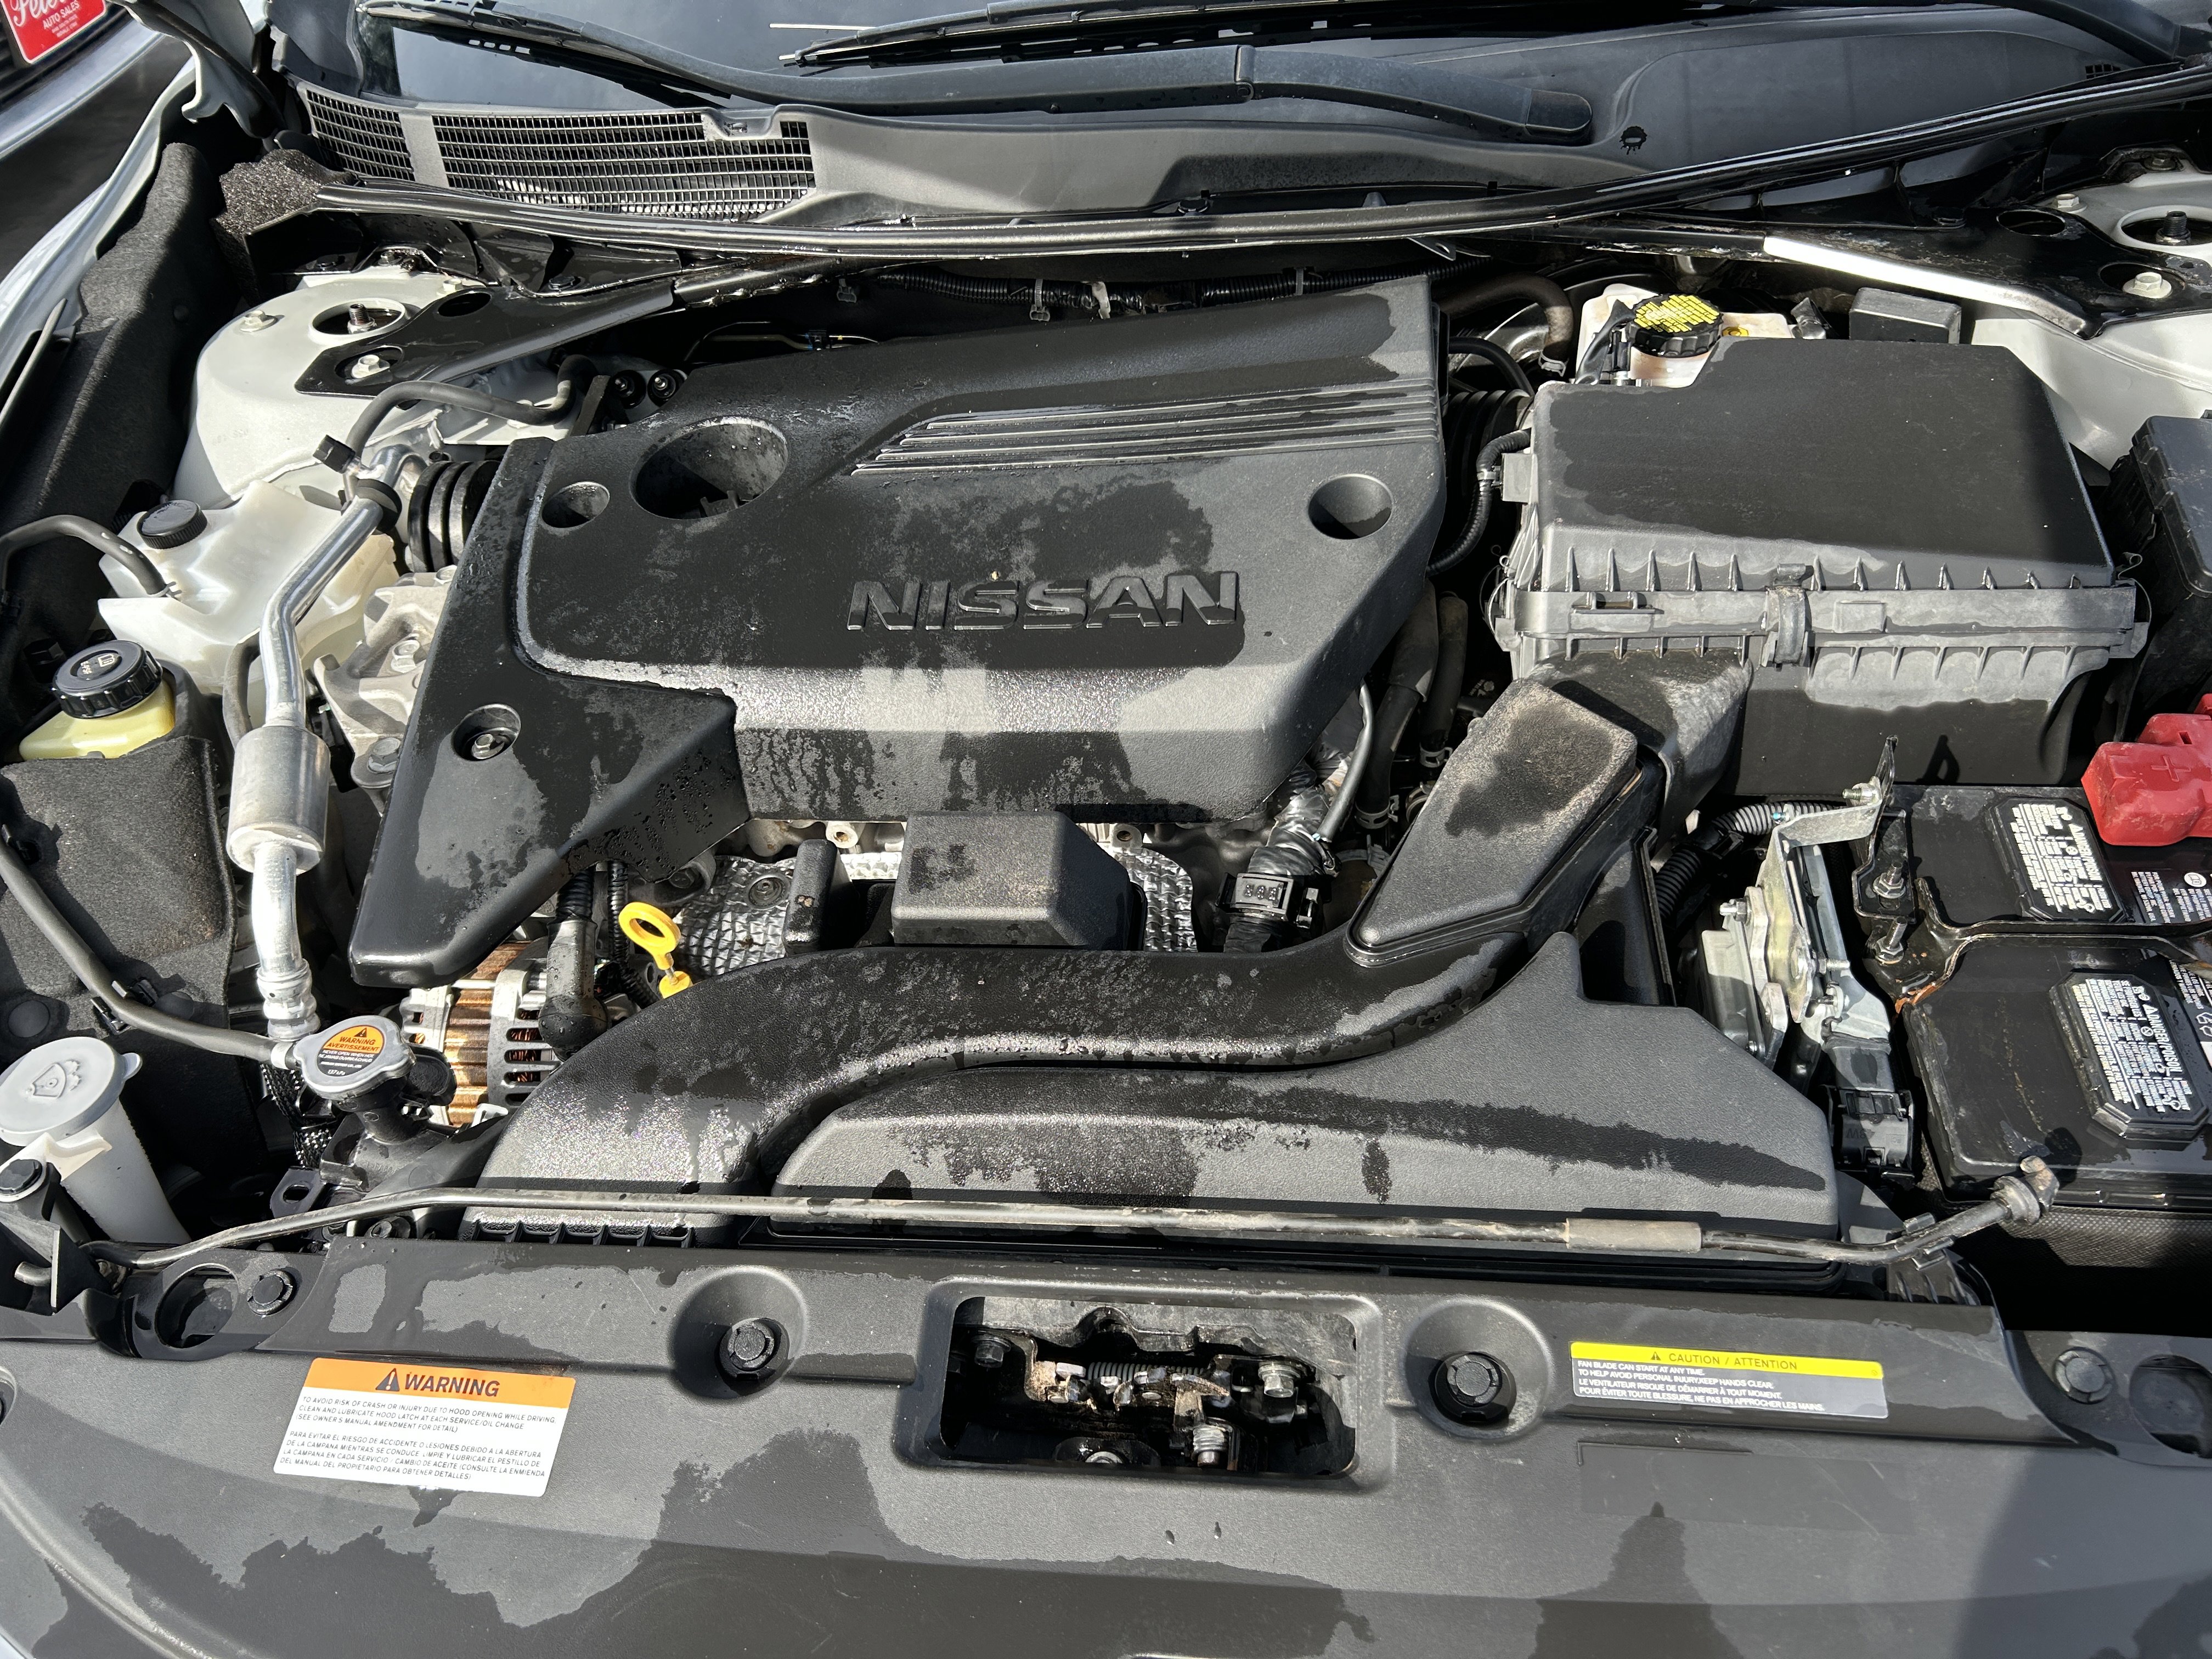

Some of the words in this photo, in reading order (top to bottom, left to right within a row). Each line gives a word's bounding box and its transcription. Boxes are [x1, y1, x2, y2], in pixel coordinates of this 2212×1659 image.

[43, 13, 60, 29] AUTO
[60, 1, 80, 18] SALES
[847, 571, 1239, 630] NISSAN
[2072, 832, 2102, 881] DANGER/POISON
[328, 1042, 380, 1052] AVERTISSEMENT
[340, 1036, 376, 1045] WARNING
[2147, 1014, 2182, 1072] DANGER/POISON
[1593, 1361, 1617, 1370] BLADE
[1618, 1363, 1635, 1371] CAN
[1669, 1353, 1720, 1365] CAUTION
[1724, 1357, 1730, 1365] /
[1734, 1358, 1797, 1370] ATTENTION
[405, 1374, 500, 1397] WARNING
[1589, 1379, 1636, 1389] VENTILATEUR
[1637, 1382, 1665, 1391] RISQUE
[1678, 1384, 1719, 1395] DÉMARRER
[1719, 1386, 1726, 1396] À
[1747, 1390, 1782, 1400] MOMENT.
[1610, 1371, 1633, 1379] AVOID
[1633, 1373, 1673, 1382] PERSONAL
[1719, 1379, 1747, 1387] HANDS
[1747, 1380, 1774, 1389] CLEAR.
[1579, 1386, 1601, 1395] POUR
[1601, 1386, 1627, 1397] ÉVITER
[1627, 1390, 1652, 1399] TOUTE
[1652, 1392, 1694, 1402] BLESSURE,
[1706, 1396, 1722, 1404] PAS
[1722, 1397, 1734, 1405] EN
[1734, 1397, 1781, 1408] APPROCHER
[1782, 1401, 1798, 1409] LES
[1797, 1402, 1826, 1412] MAINS.
[337, 1409, 375, 1417] LUBRICATE
[449, 1417, 493, 1427] SERVICE/OIL
[495, 1421, 524, 1430] CHANGE
[448, 1408, 470, 1416] HOOD
[472, 1410, 503, 1419] OPENING
[313, 1415, 343, 1423] OWNERS
[345, 1418, 371, 1426] MANUAL
[373, 1420, 416, 1429] AMENDMENT
[432, 1424, 458, 1434] DETAIL)
[307, 1441, 338, 1449] CAMPANA
[340, 1444, 374, 1453] MIENTRAS
[452, 1454, 486, 1462] LUBRICAR
[497, 1458, 529, 1466] PESTILLO
[341, 1435, 368, 1443] RIESGO
[379, 1438, 417, 1447] ACCIDENTE
[425, 1442, 460, 1451] LESIONES
[460, 1445, 488, 1453] DEBIDO
[505, 1449, 541, 1458] ABERTURA
[293, 1449, 324, 1457] CAMPANA
[357, 1454, 388, 1463] SERVICIO
[395, 1458, 421, 1466] CAMBIO
[432, 1461, 458, 1469] ACEITE
[459, 1464, 497, 1473] (CONSULTE
[509, 1468, 545, 1476] ENMIENDA
[337, 1462, 381, 1472] PROPIETARIO
[402, 1468, 433, 1476] OBTENER
[434, 1470, 471, 1480] DETALLES)
